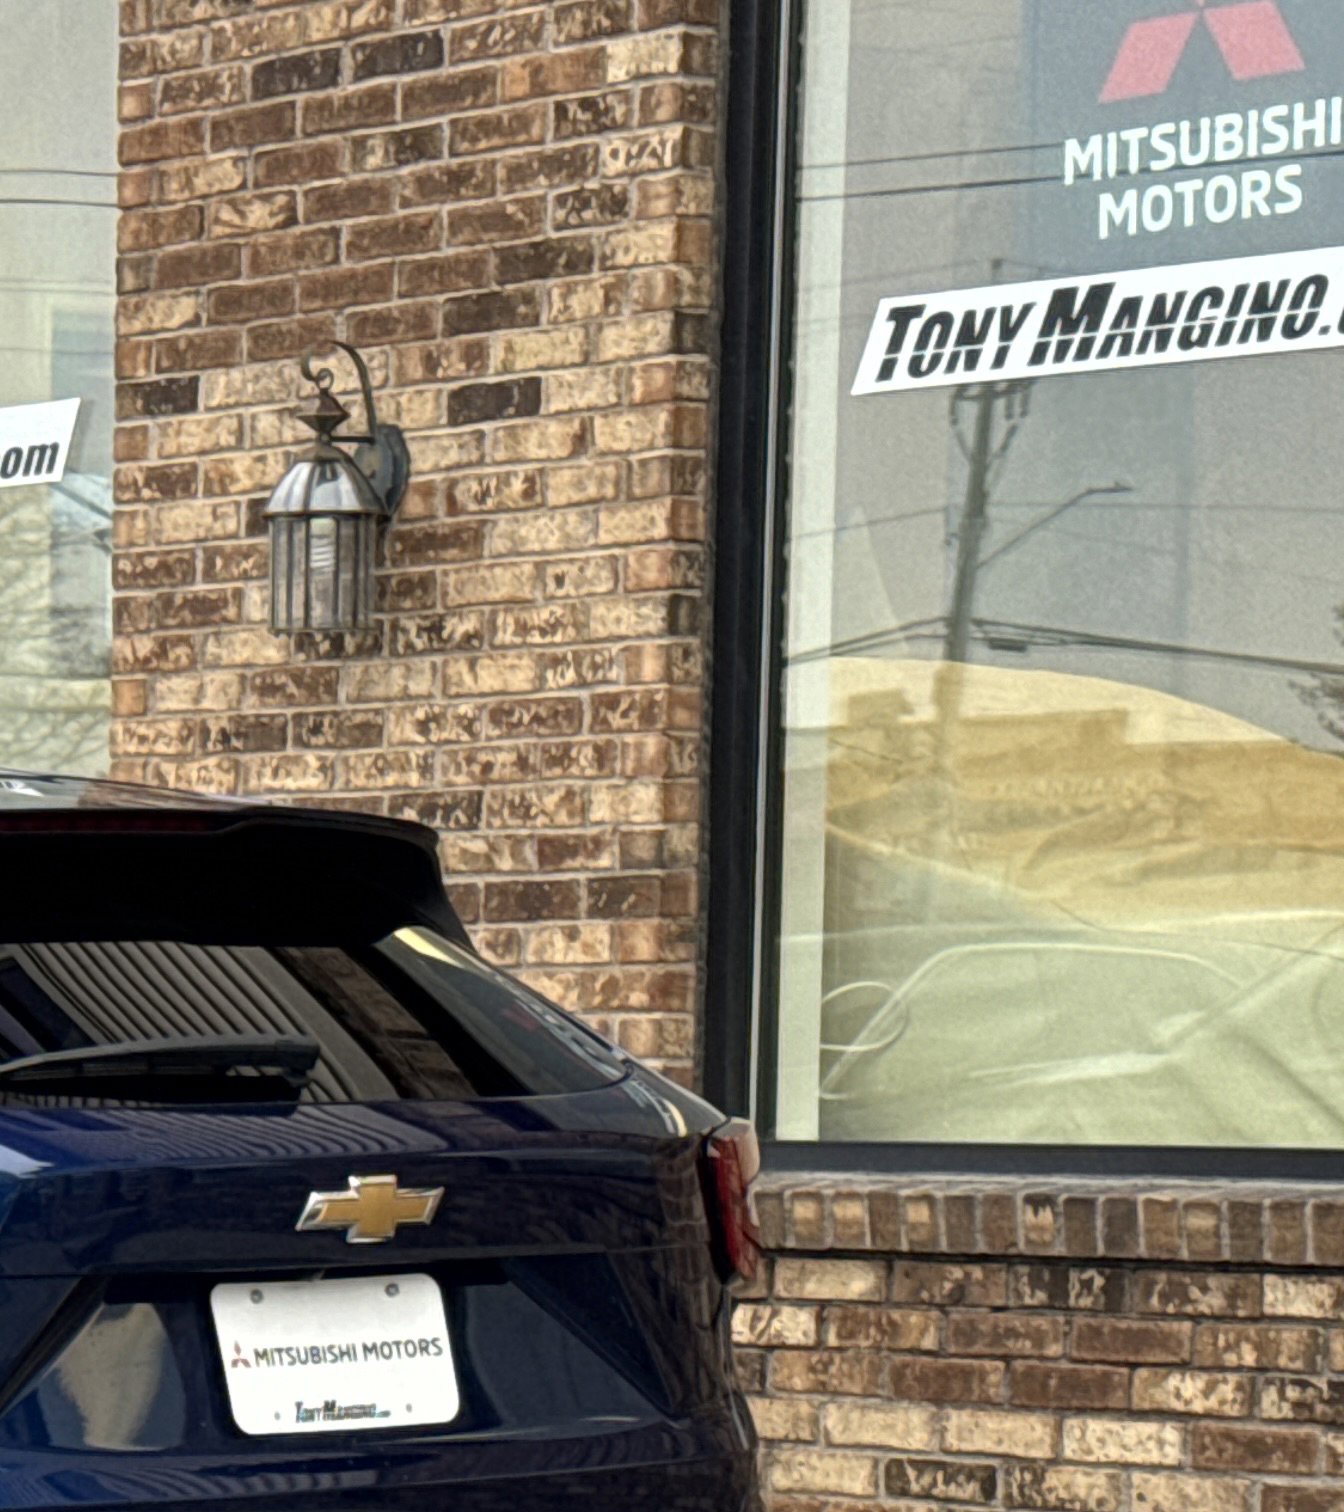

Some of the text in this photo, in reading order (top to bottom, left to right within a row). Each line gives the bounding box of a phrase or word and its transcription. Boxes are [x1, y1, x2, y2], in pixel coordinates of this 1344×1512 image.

[1063, 96, 1343, 185] MITSUBISHI
[1098, 164, 1304, 240] MOTORS
[874, 273, 1344, 384] TONYMANGINO.
[253, 1337, 444, 1368] MITSUBISHI MOTORS
